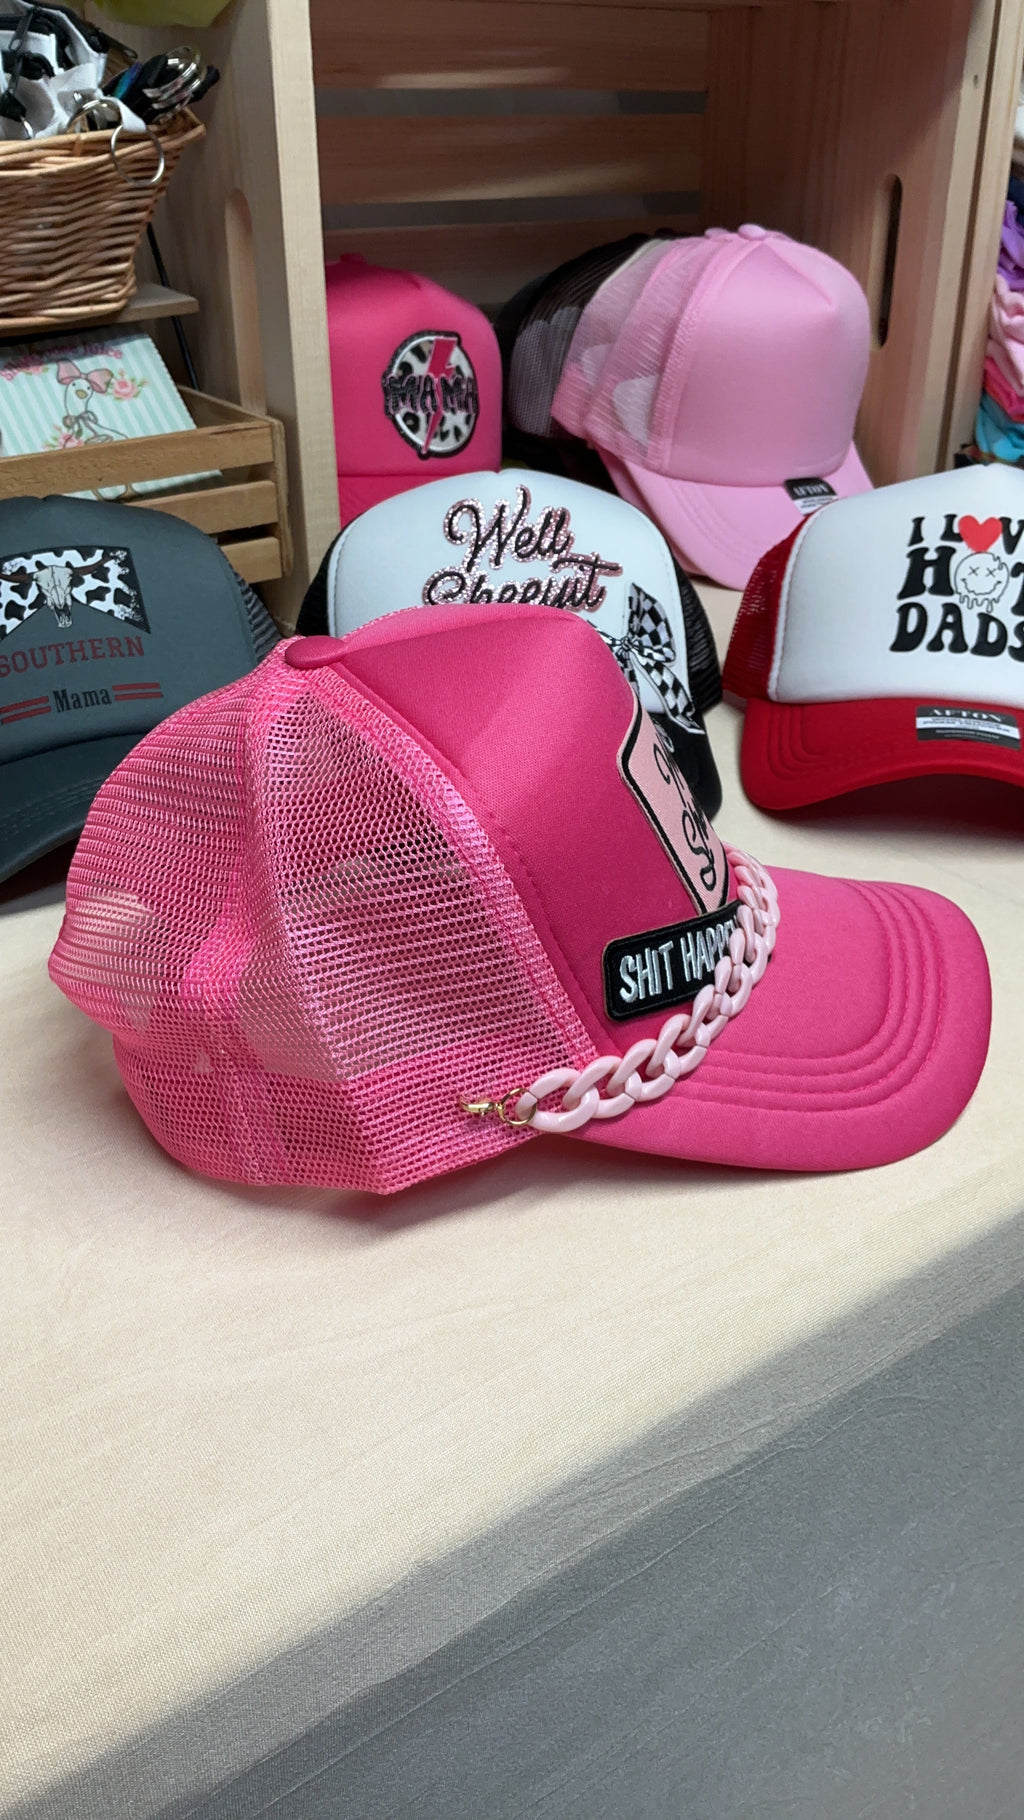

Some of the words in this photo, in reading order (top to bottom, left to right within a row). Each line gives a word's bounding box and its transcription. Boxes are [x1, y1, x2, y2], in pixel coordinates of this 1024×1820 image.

[382, 373, 479, 415] MAMA
[444, 485, 575, 571] Well
[908, 516, 926, 547] I
[0, 635, 145, 679] SOUTHERN
[52, 687, 113, 713] Mama
[619, 941, 674, 1003] SHIT
